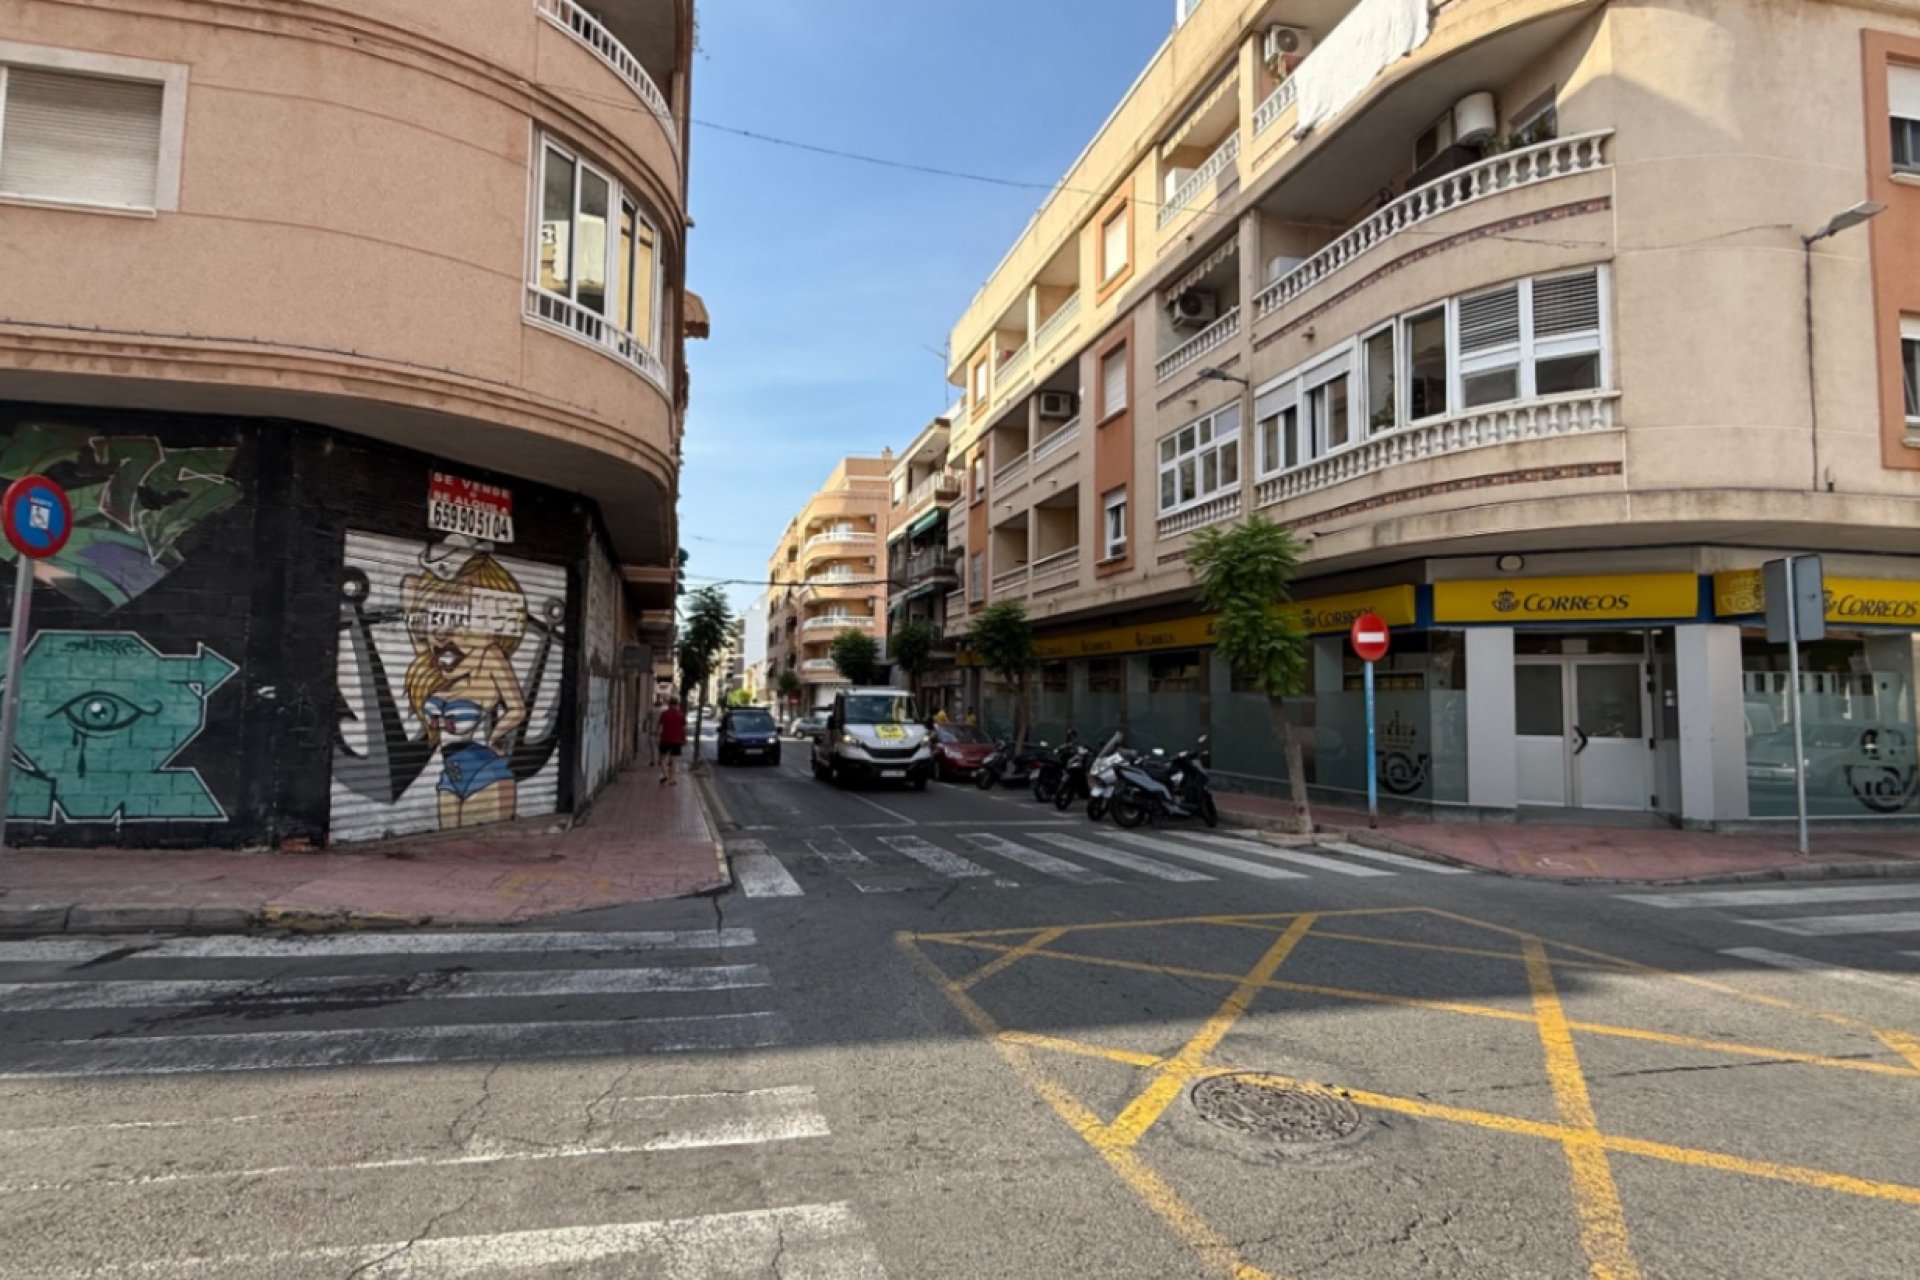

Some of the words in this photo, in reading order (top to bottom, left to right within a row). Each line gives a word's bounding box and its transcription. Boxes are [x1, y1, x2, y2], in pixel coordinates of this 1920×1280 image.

[433, 491, 450, 502] SE
[434, 472, 454, 485] SE
[462, 479, 511, 499] VENDE
[1523, 592, 1632, 613] CORREOS
[1838, 594, 1917, 617] CORREOS
